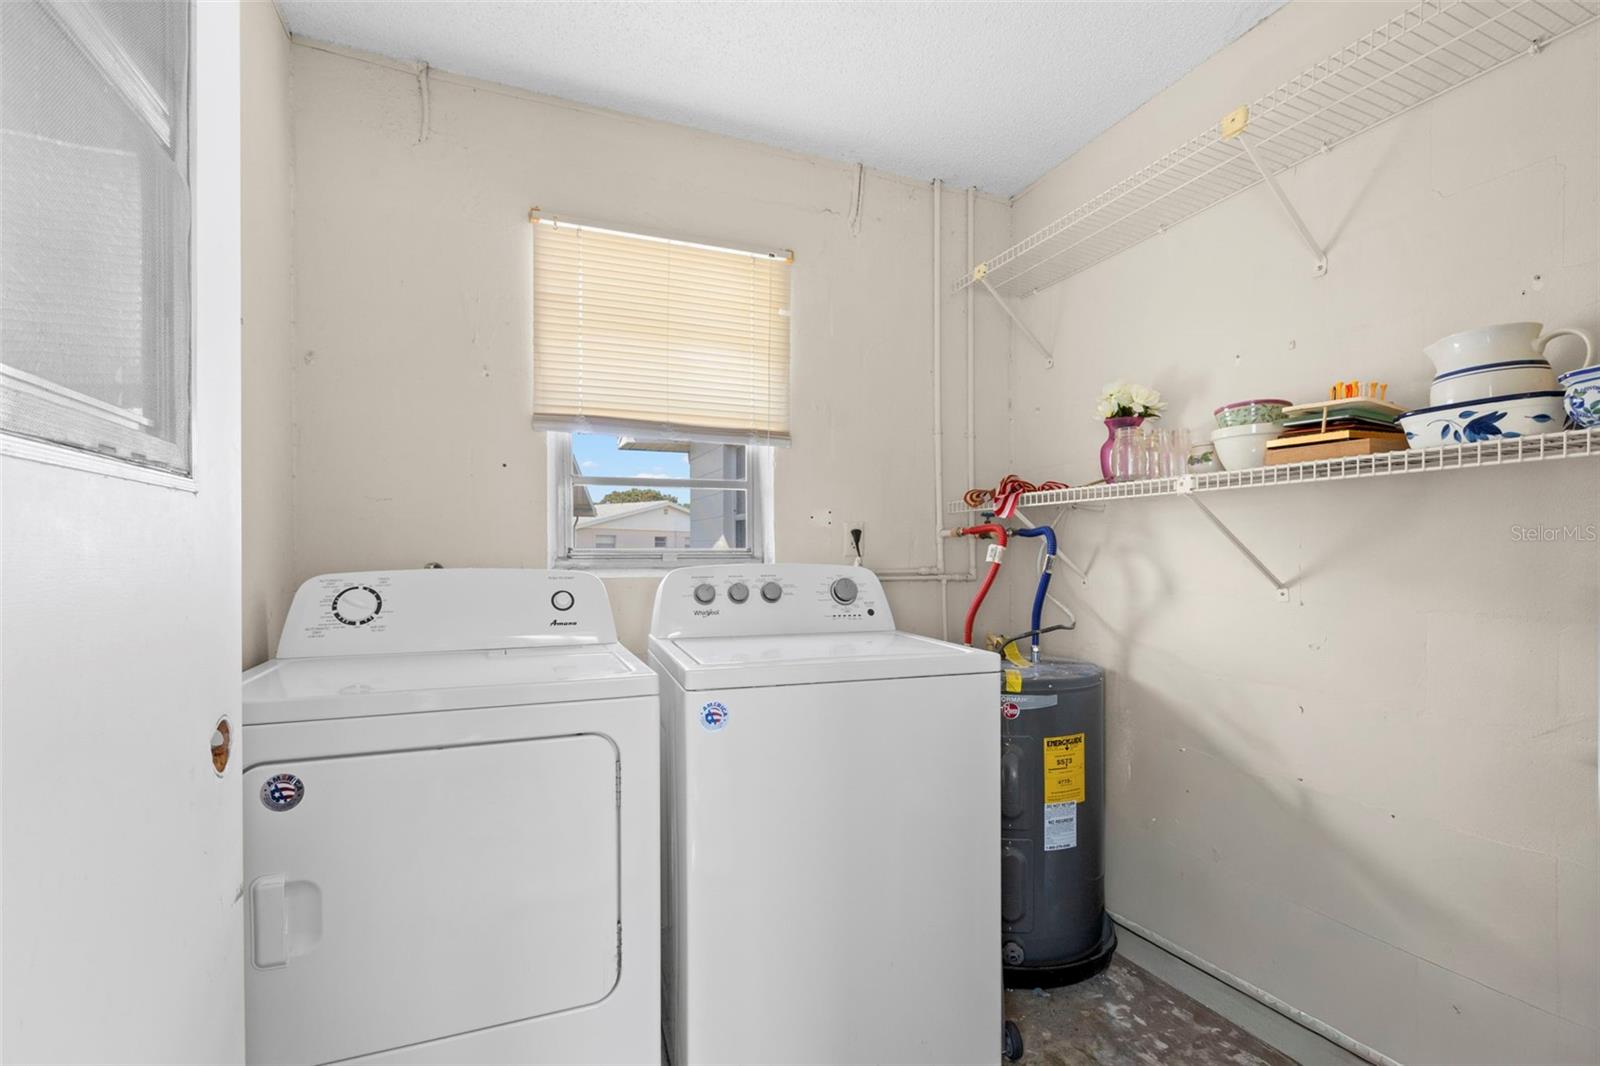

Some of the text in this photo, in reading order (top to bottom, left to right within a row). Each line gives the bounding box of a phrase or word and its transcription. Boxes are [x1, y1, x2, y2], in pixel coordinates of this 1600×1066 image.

[693, 609, 720, 617] Whirlpool
[703, 701, 728, 717] AMERICA
[266, 774, 303, 791] AMERICA
